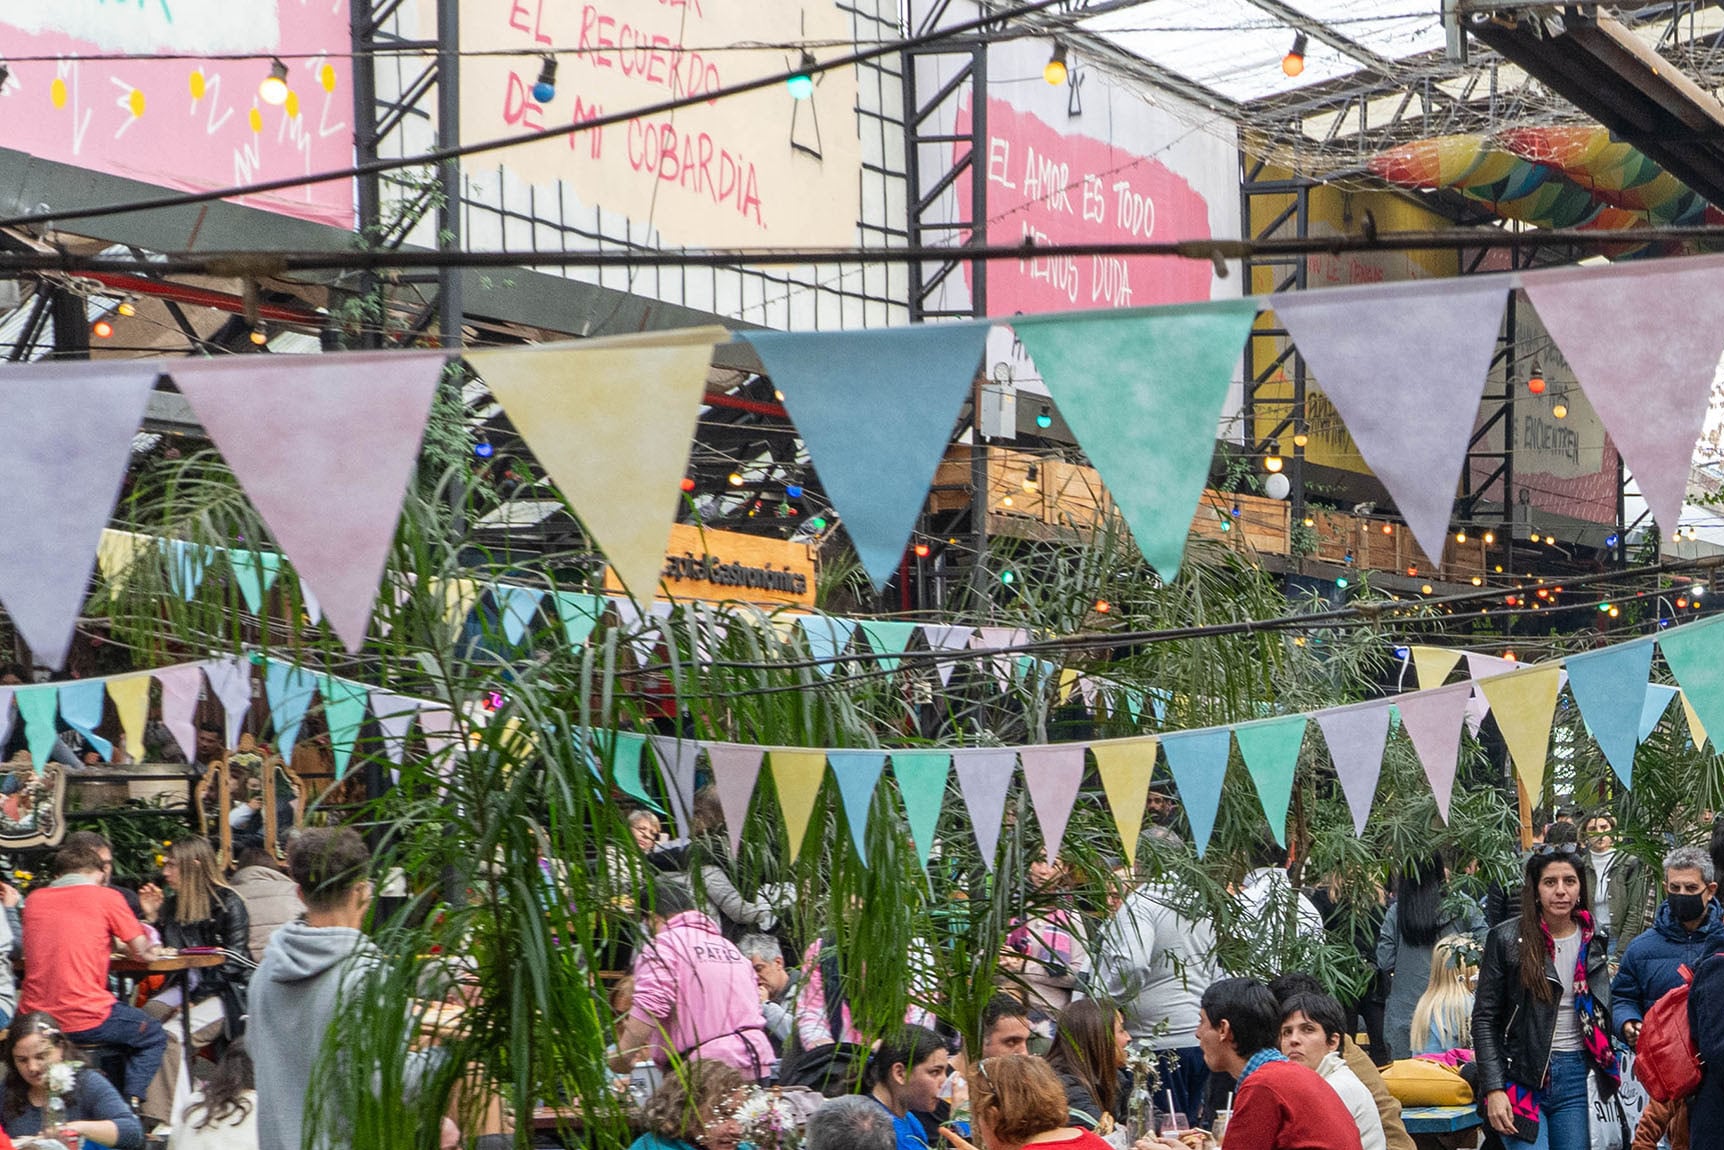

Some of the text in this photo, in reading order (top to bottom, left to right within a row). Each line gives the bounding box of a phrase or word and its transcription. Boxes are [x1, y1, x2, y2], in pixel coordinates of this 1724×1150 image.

[509, 0, 721, 107] EL RECUERDO
[503, 71, 545, 132] DE
[987, 136, 1155, 238] EL AMOR ES TODO
[1020, 220, 1133, 308] MENOS DUDA
[694, 946, 741, 961] PATIO
